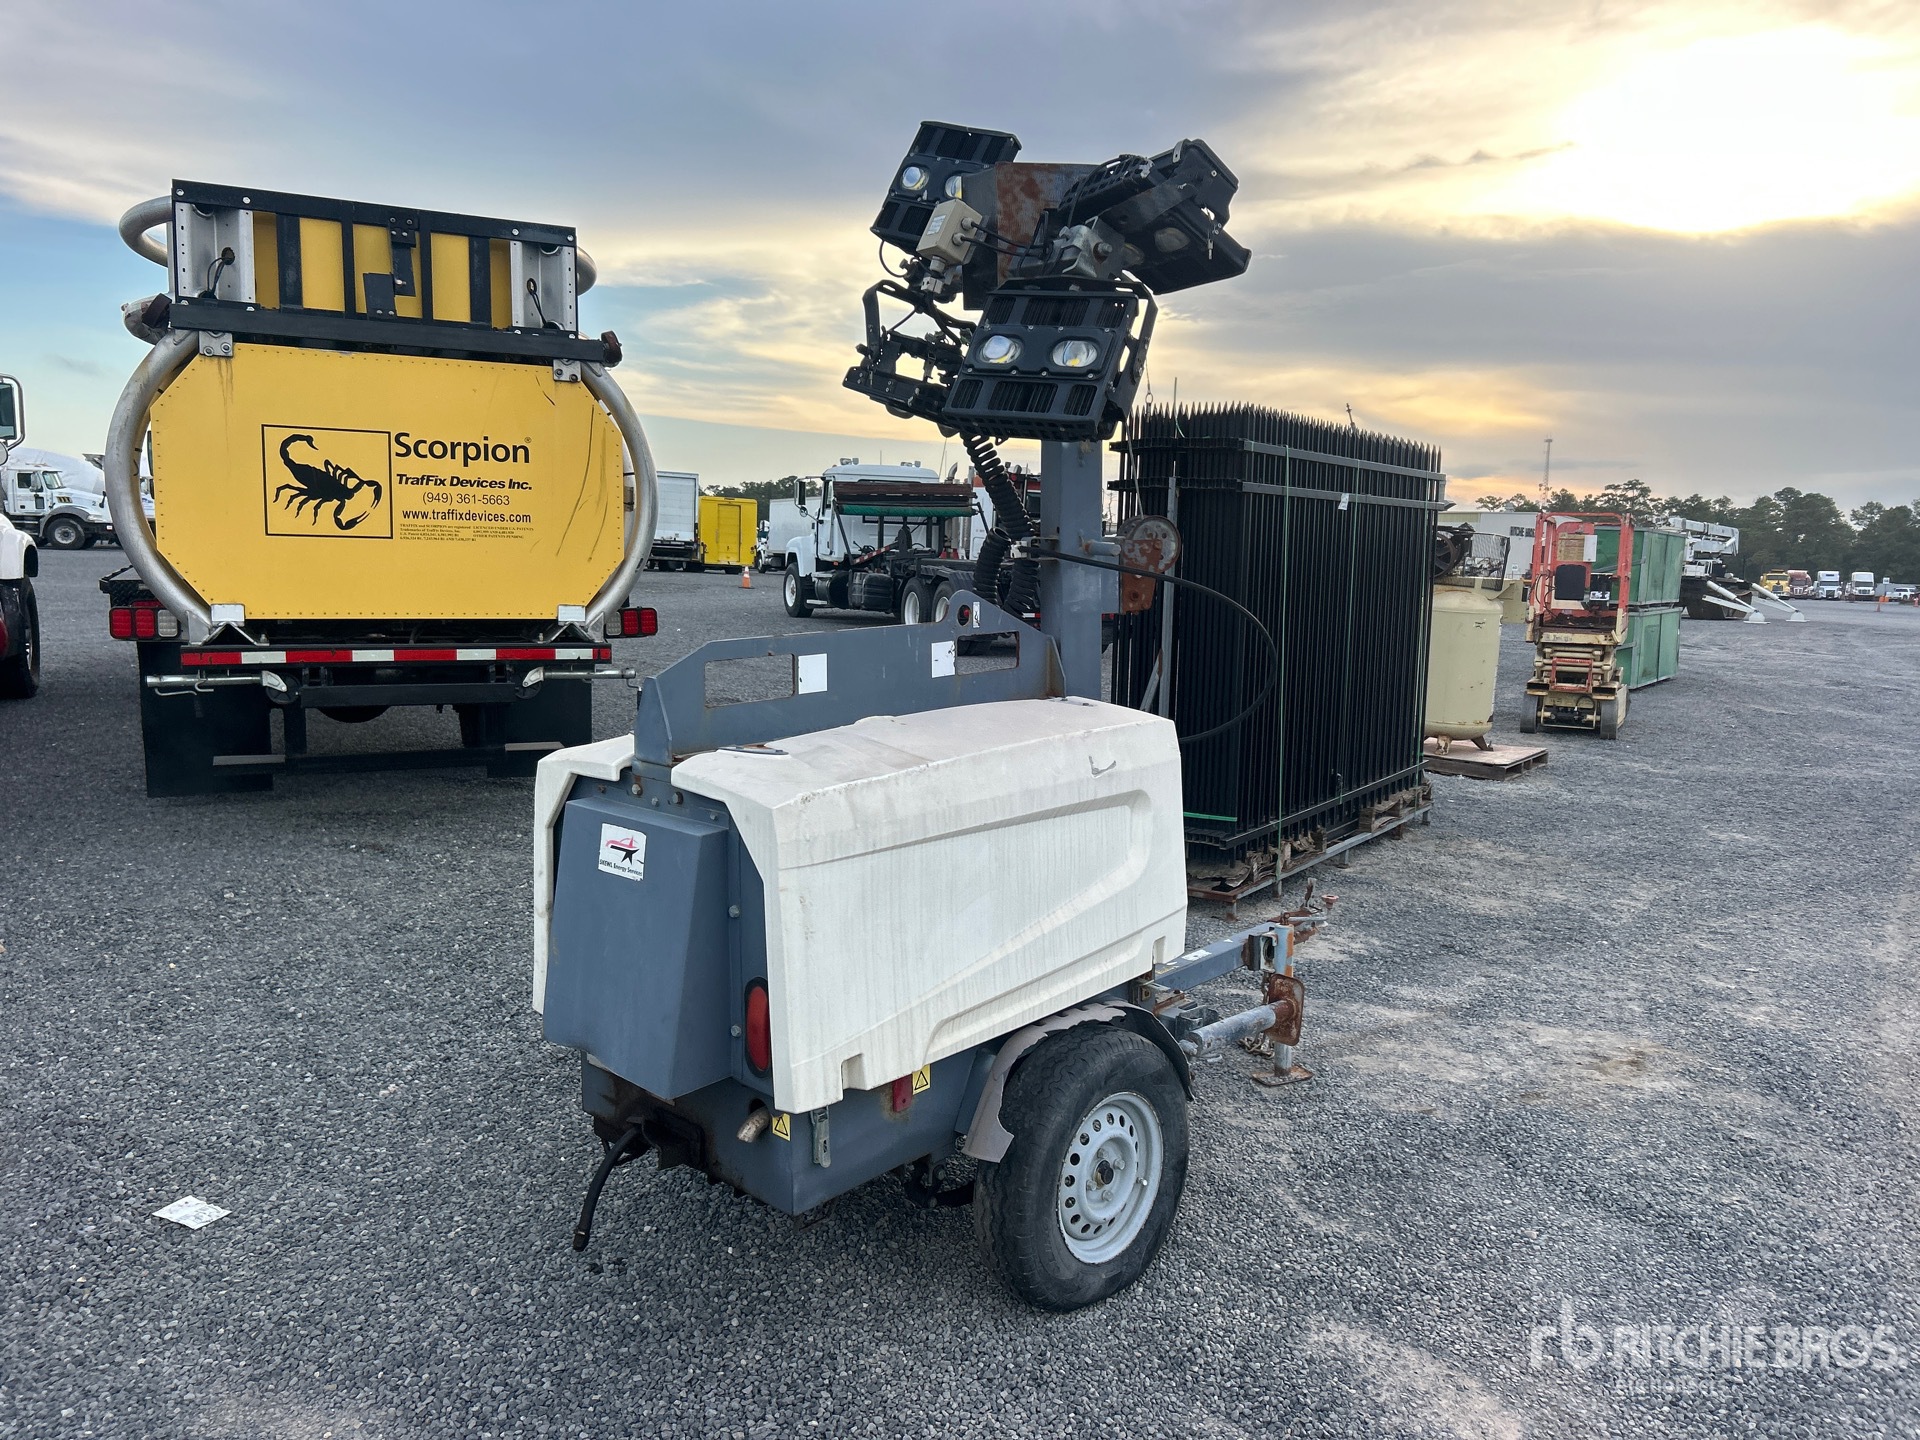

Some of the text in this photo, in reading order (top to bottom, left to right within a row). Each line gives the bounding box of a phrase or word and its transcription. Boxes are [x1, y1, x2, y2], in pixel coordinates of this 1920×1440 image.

[394, 432, 530, 467] Scorpion
[396, 473, 533, 490] TrafFix Devices Inc.
[422, 492, 510, 506] (949) 361-5663
[402, 508, 532, 523] www.traffixdevices.com
